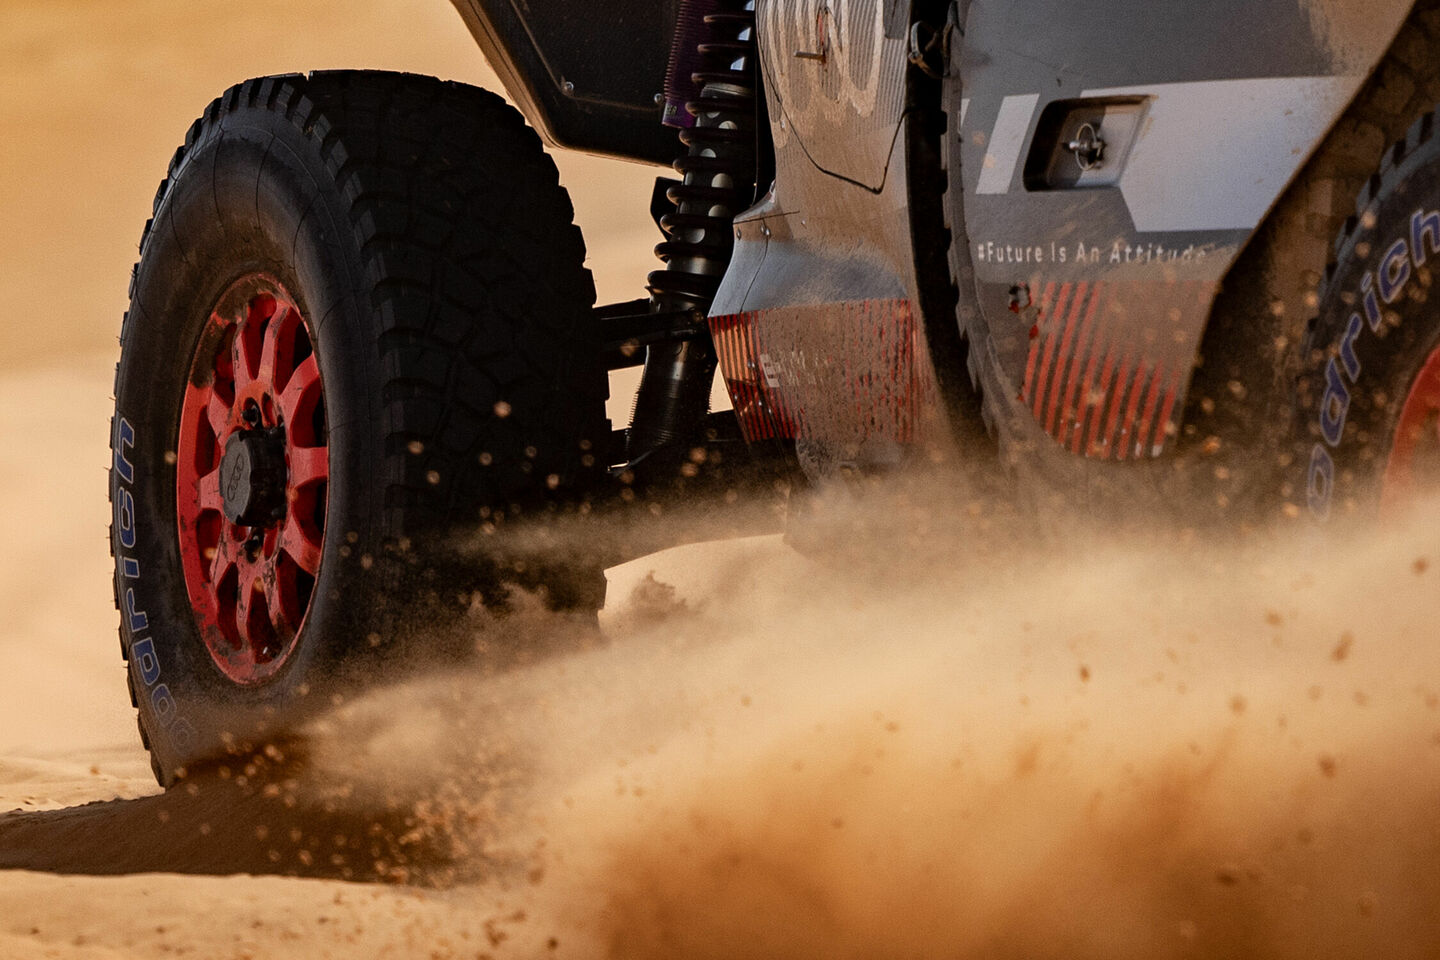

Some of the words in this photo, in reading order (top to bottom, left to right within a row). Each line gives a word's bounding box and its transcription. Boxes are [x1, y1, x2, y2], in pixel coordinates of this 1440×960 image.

[978, 241, 1042, 263] #Future
[1051, 241, 1067, 263] Is
[1076, 241, 1100, 263] An
